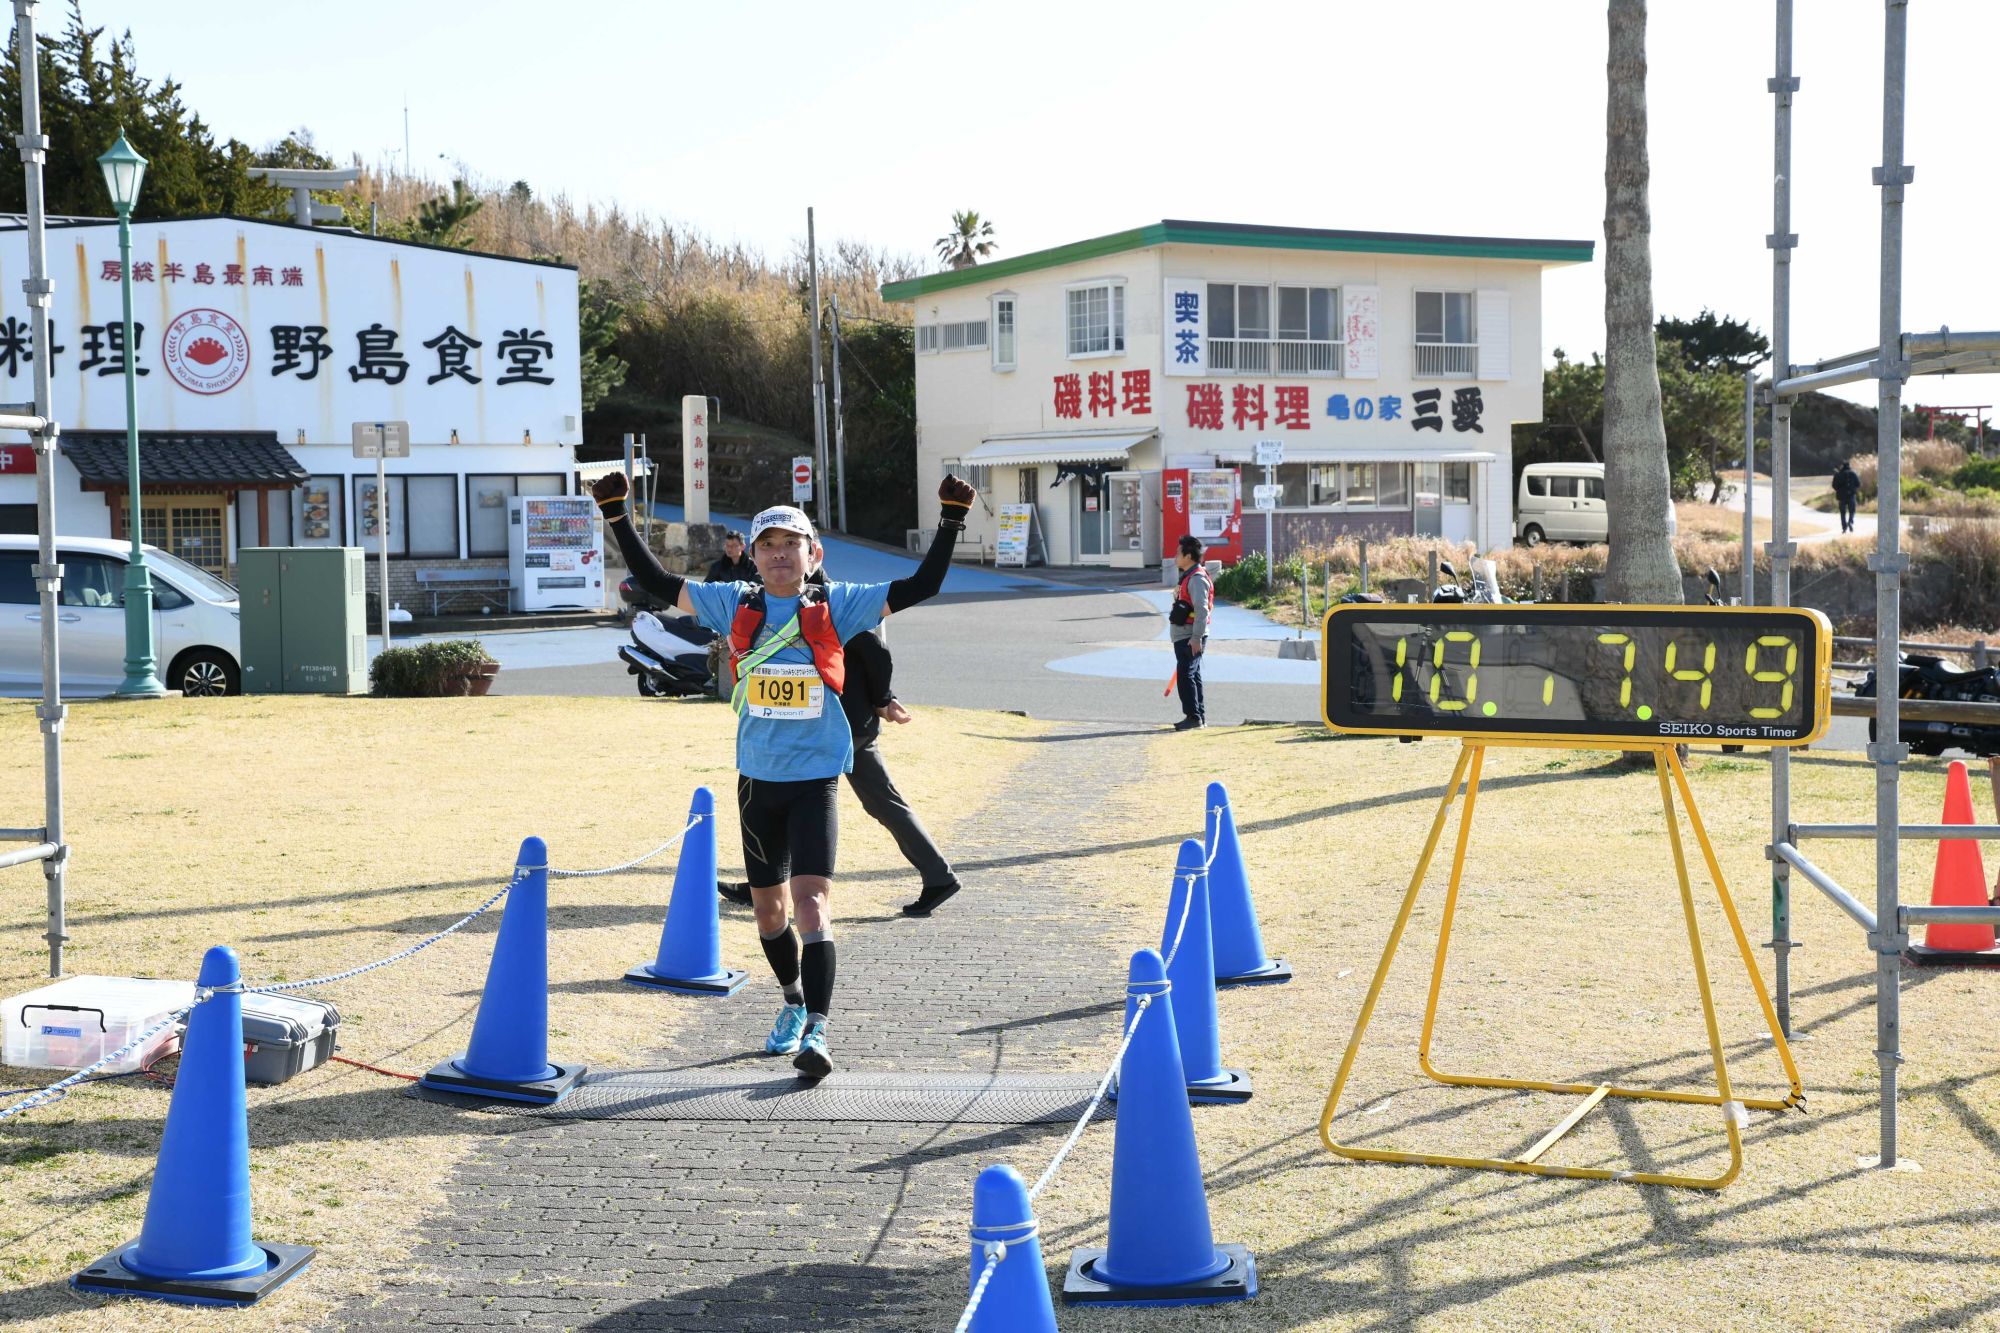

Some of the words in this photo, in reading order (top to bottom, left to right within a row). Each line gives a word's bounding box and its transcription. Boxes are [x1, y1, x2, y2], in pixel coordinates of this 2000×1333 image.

[101, 260, 304, 287] 房総半島最南端
[1175, 291, 1200, 364] 喫茶
[270, 322, 555, 386] 野島食堂
[176, 366, 204, 389] NOJIMA
[205, 366, 240, 389] SHOKUDO
[1053, 368, 1152, 419] 磯料理
[1186, 383, 1311, 431] 磯料理
[1327, 394, 1402, 422] 亀の家
[1411, 386, 1484, 434] 三愛
[758, 679, 805, 701] 1091
[1659, 722, 1713, 735] SEIKO
[1716, 725, 1758, 737] Sports
[1761, 726, 1798, 737] Timer
